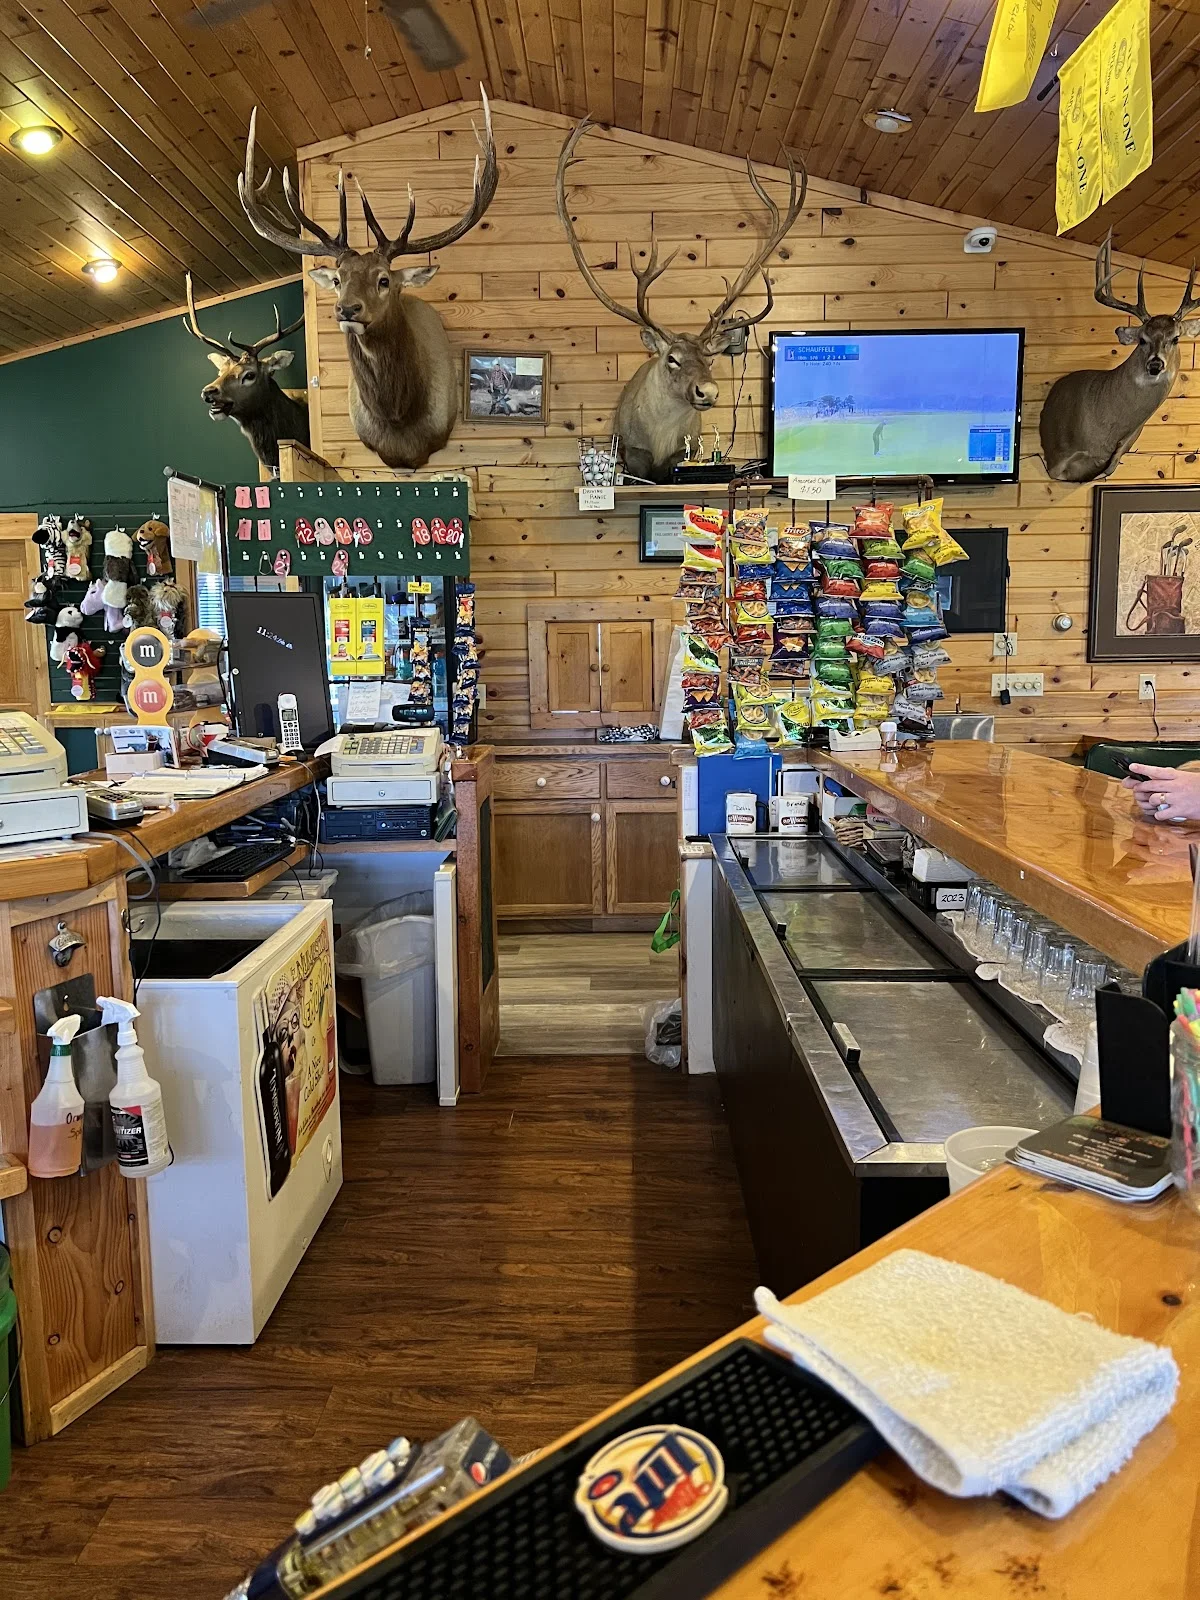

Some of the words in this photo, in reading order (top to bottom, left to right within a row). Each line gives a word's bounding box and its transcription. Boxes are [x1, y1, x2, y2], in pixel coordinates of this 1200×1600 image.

[792, 476, 816, 484] Assorted
[817, 476, 832, 485] Chips
[297, 528, 315, 543] 12
[338, 528, 352, 543] 14
[359, 528, 373, 544] 15
[415, 528, 431, 543] 18
[446, 528, 460, 544] 20
[139, 643, 156, 658] m
[142, 690, 159, 704] m
[941, 892, 965, 903] 2023
[613, 1431, 701, 1534] Lite
